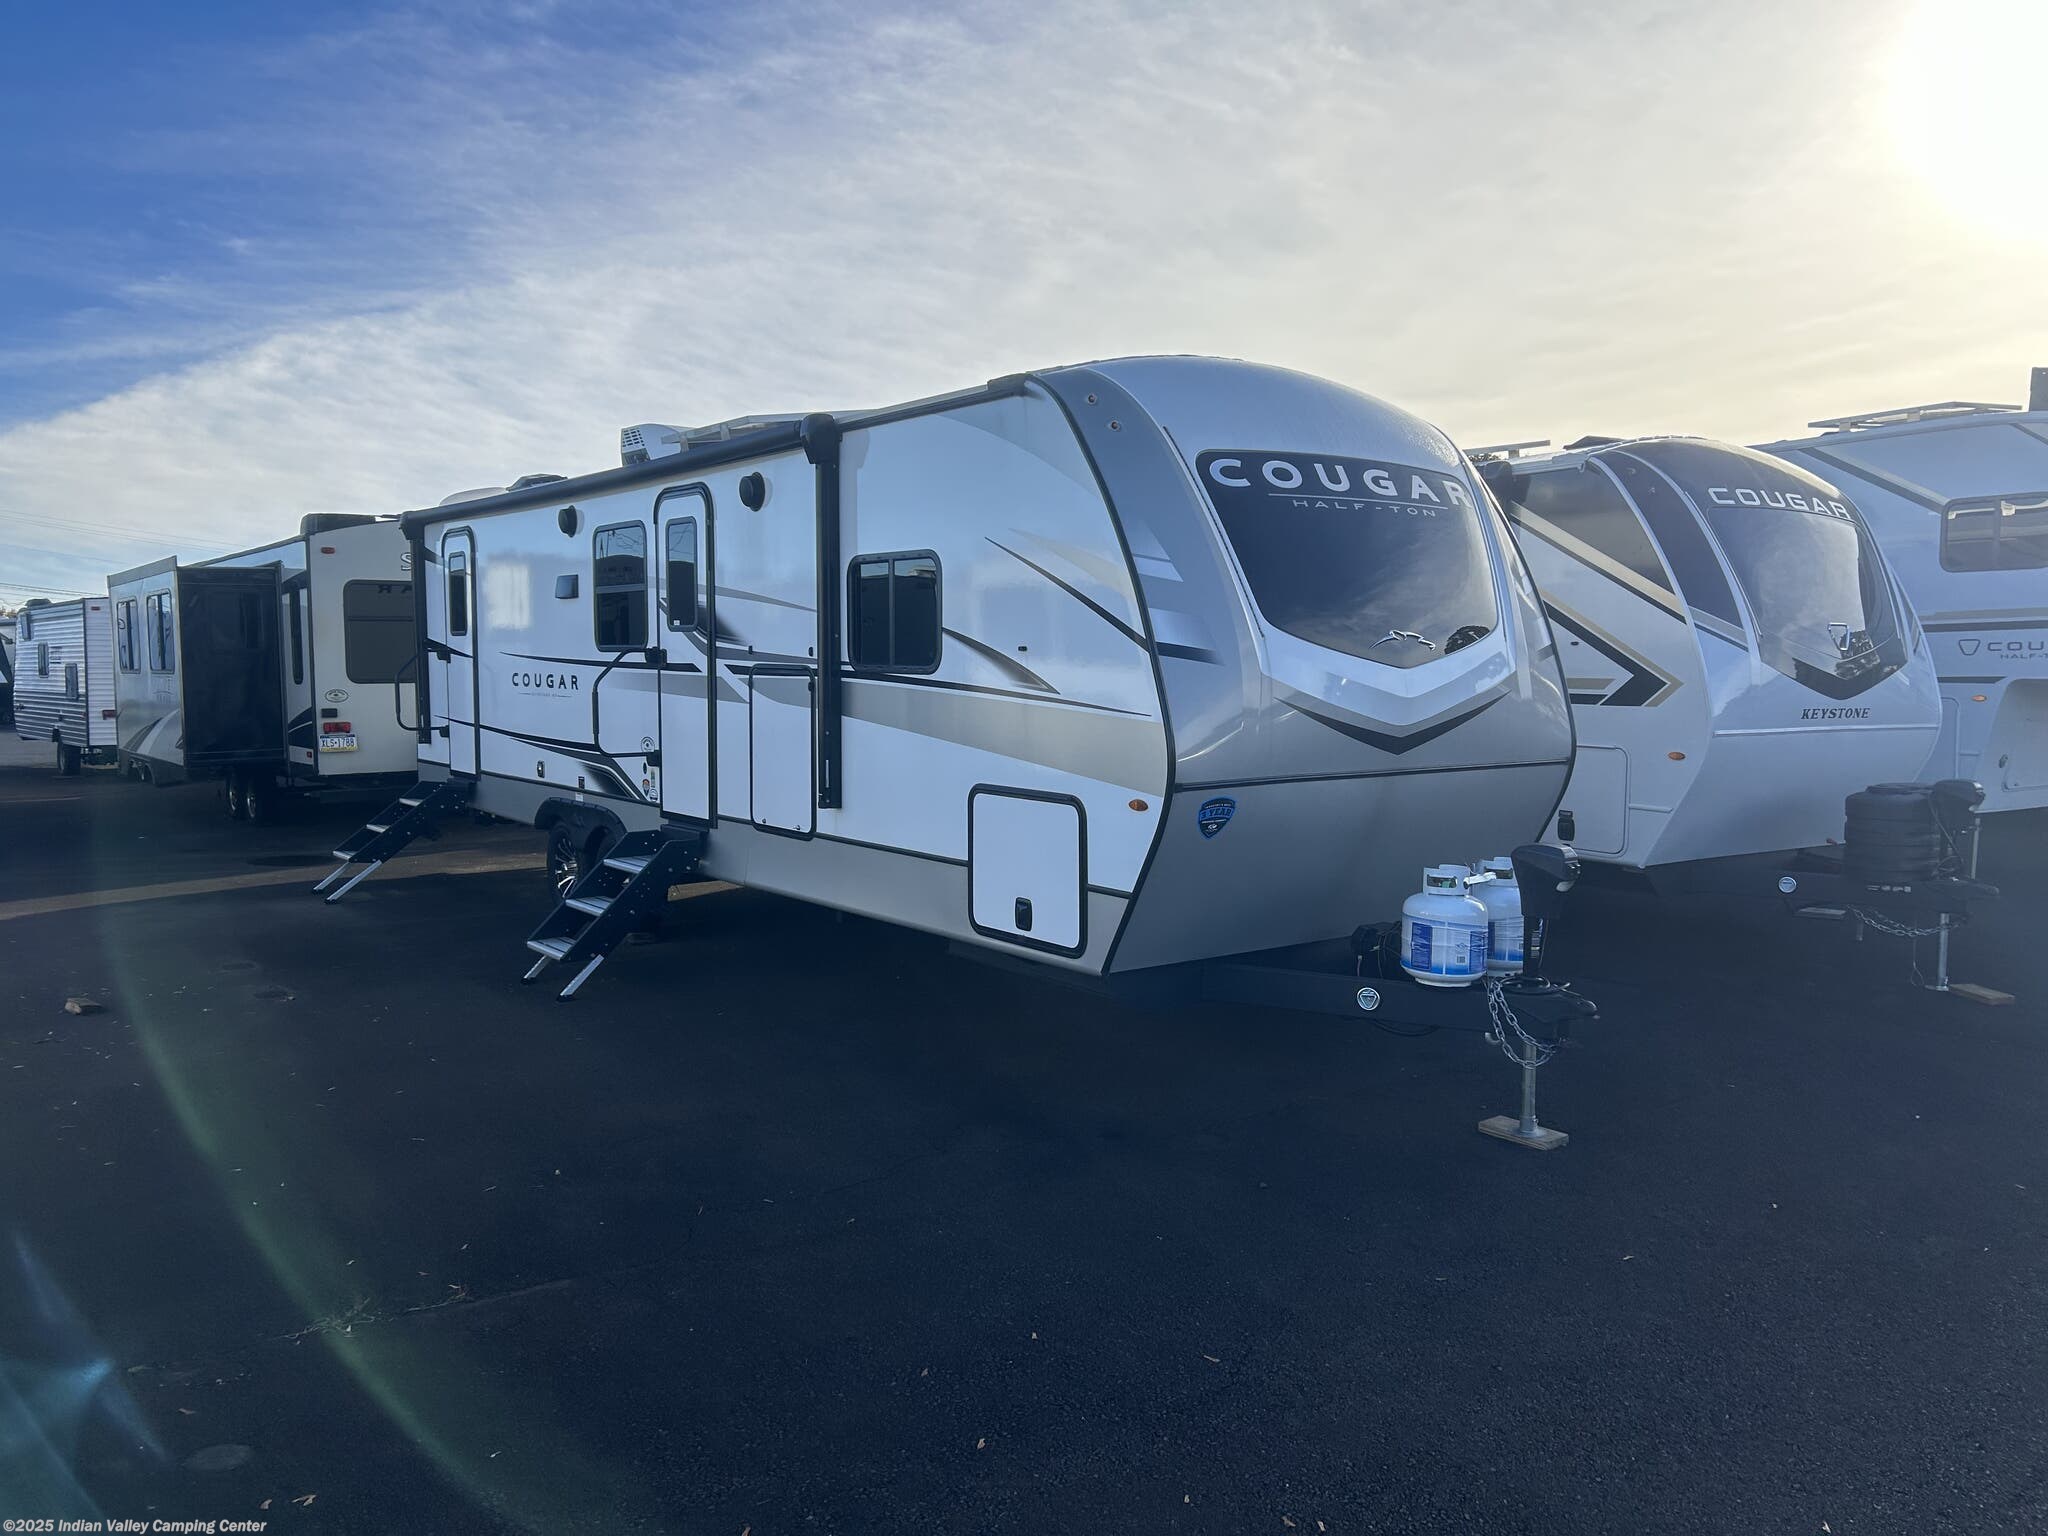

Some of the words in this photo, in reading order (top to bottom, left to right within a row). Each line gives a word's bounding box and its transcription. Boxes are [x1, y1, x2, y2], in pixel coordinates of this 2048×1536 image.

[1209, 458, 1473, 509] COUGAR
[1292, 499, 1436, 517] HALF-TON
[1707, 487, 1851, 519] COUGAR
[511, 672, 579, 690] COUGAR
[1800, 707, 1871, 720] KEYSTONE
